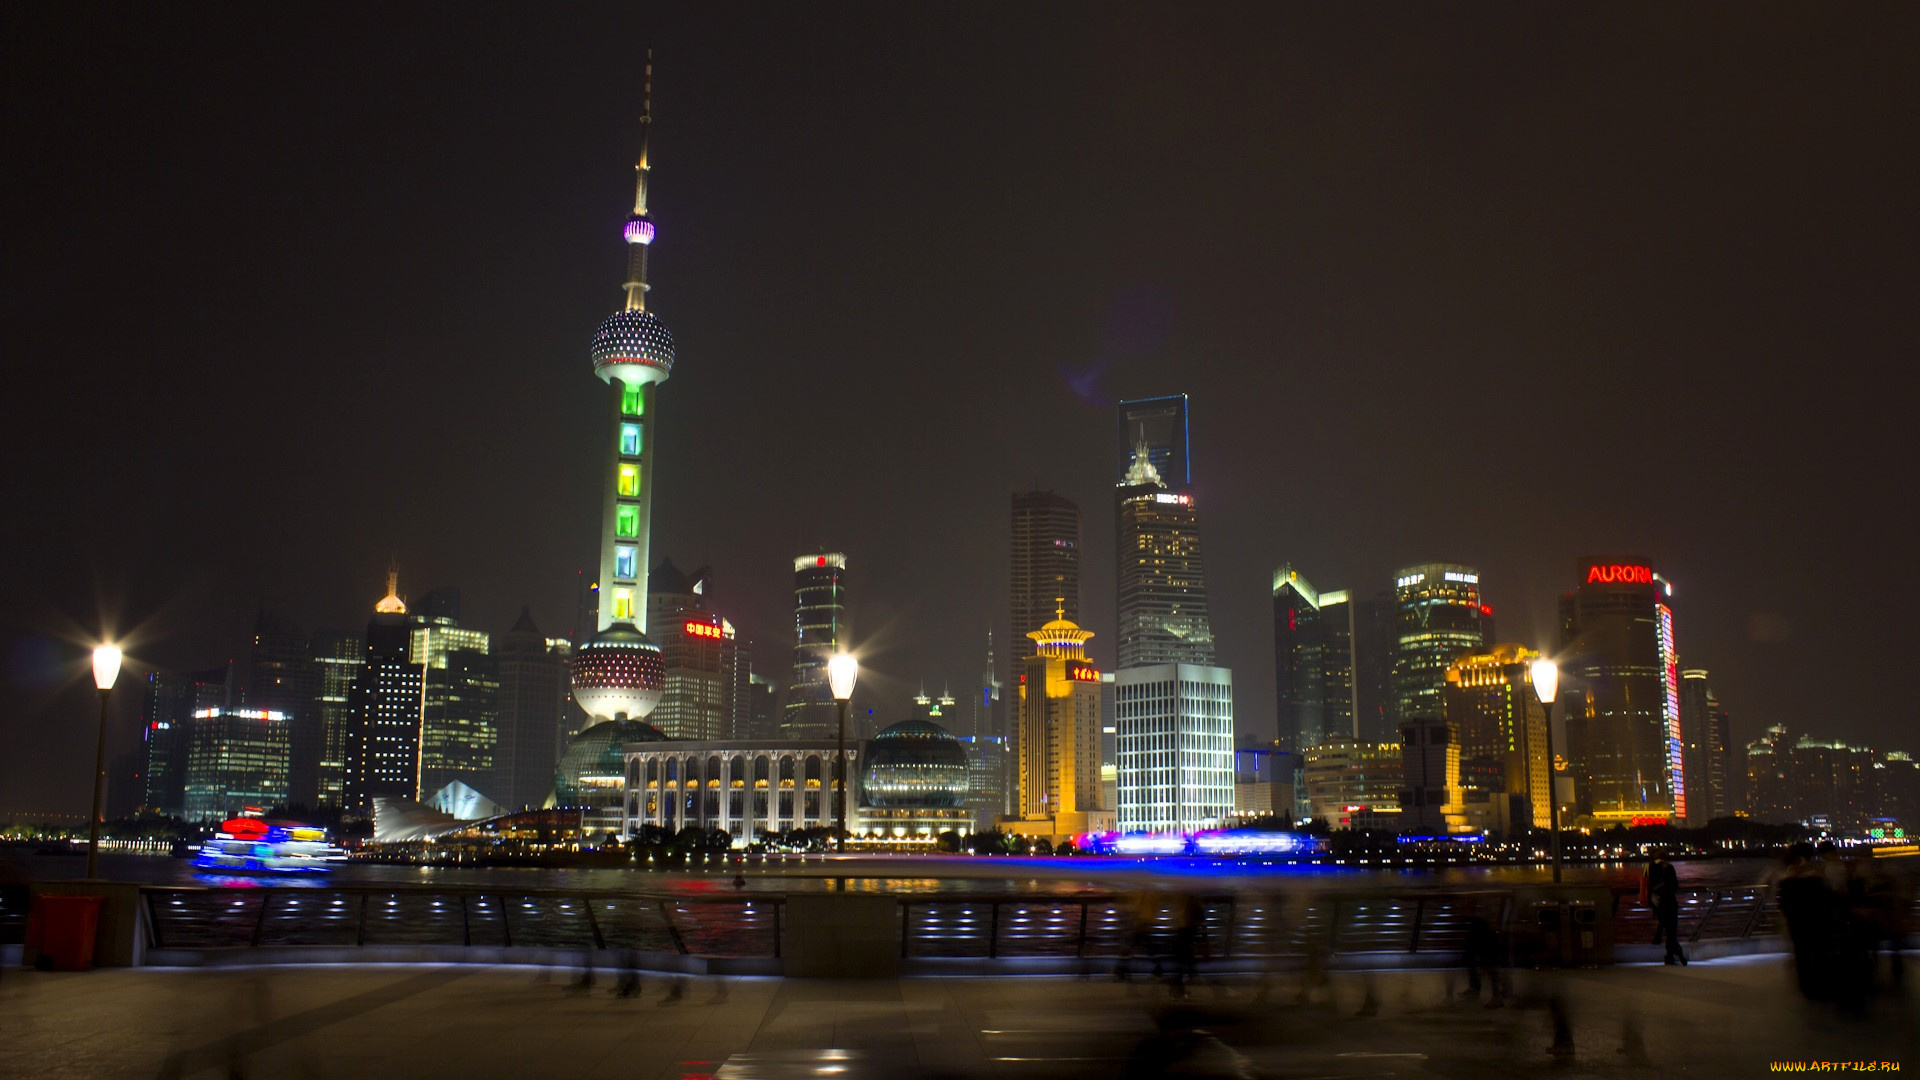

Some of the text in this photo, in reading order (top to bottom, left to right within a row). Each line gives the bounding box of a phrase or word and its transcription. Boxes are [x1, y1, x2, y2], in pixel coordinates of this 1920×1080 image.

[1587, 564, 1653, 585] AURORA
[686, 622, 721, 639] 中国平安
